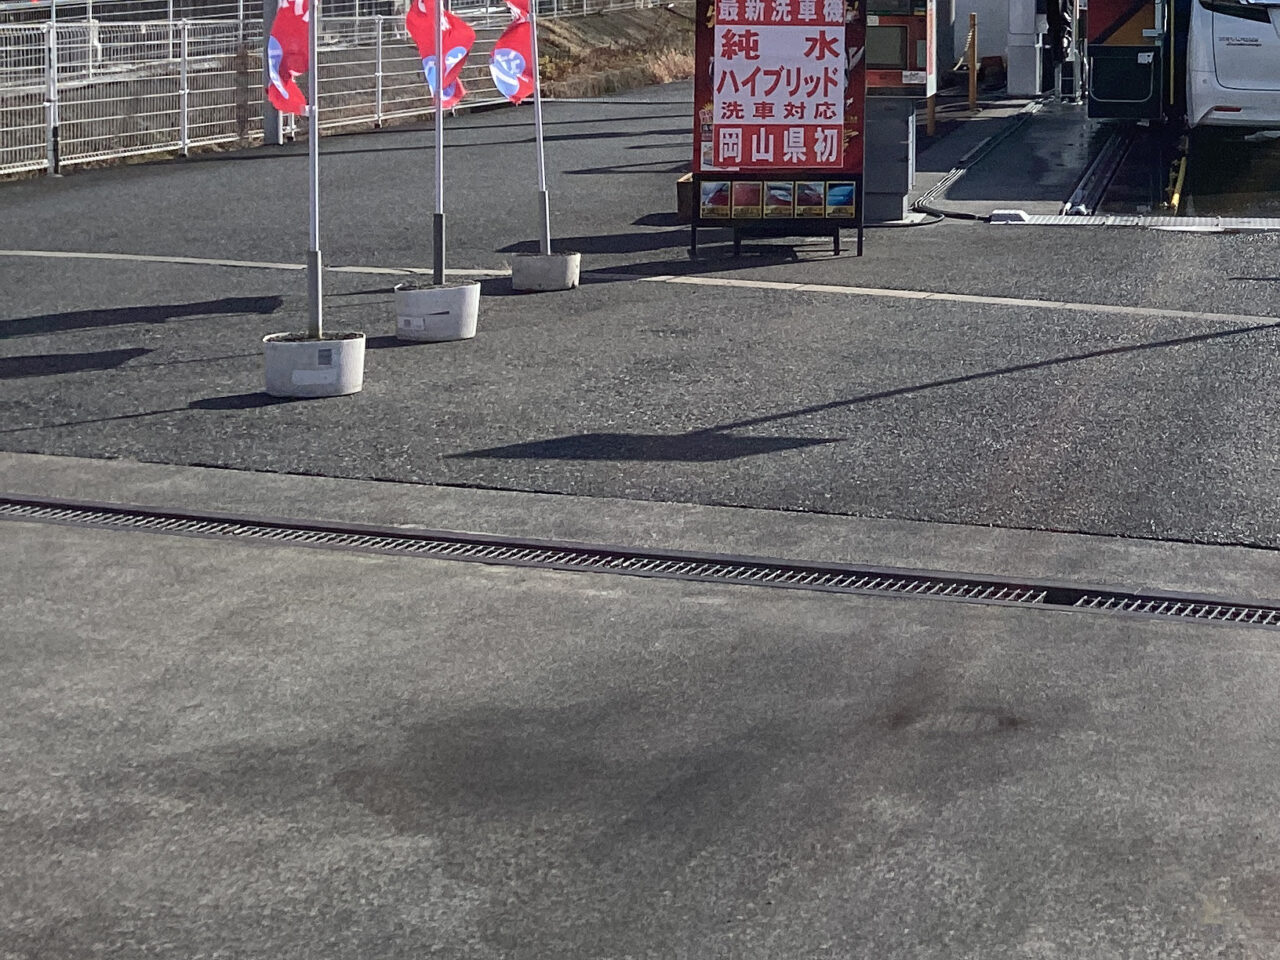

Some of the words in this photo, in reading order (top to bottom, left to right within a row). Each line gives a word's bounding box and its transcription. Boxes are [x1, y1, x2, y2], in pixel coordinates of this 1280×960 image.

[716, 65, 839, 98] ハイブリッド
[720, 101, 837, 120] 洗車対応
[718, 127, 838, 163] 岡山県初
